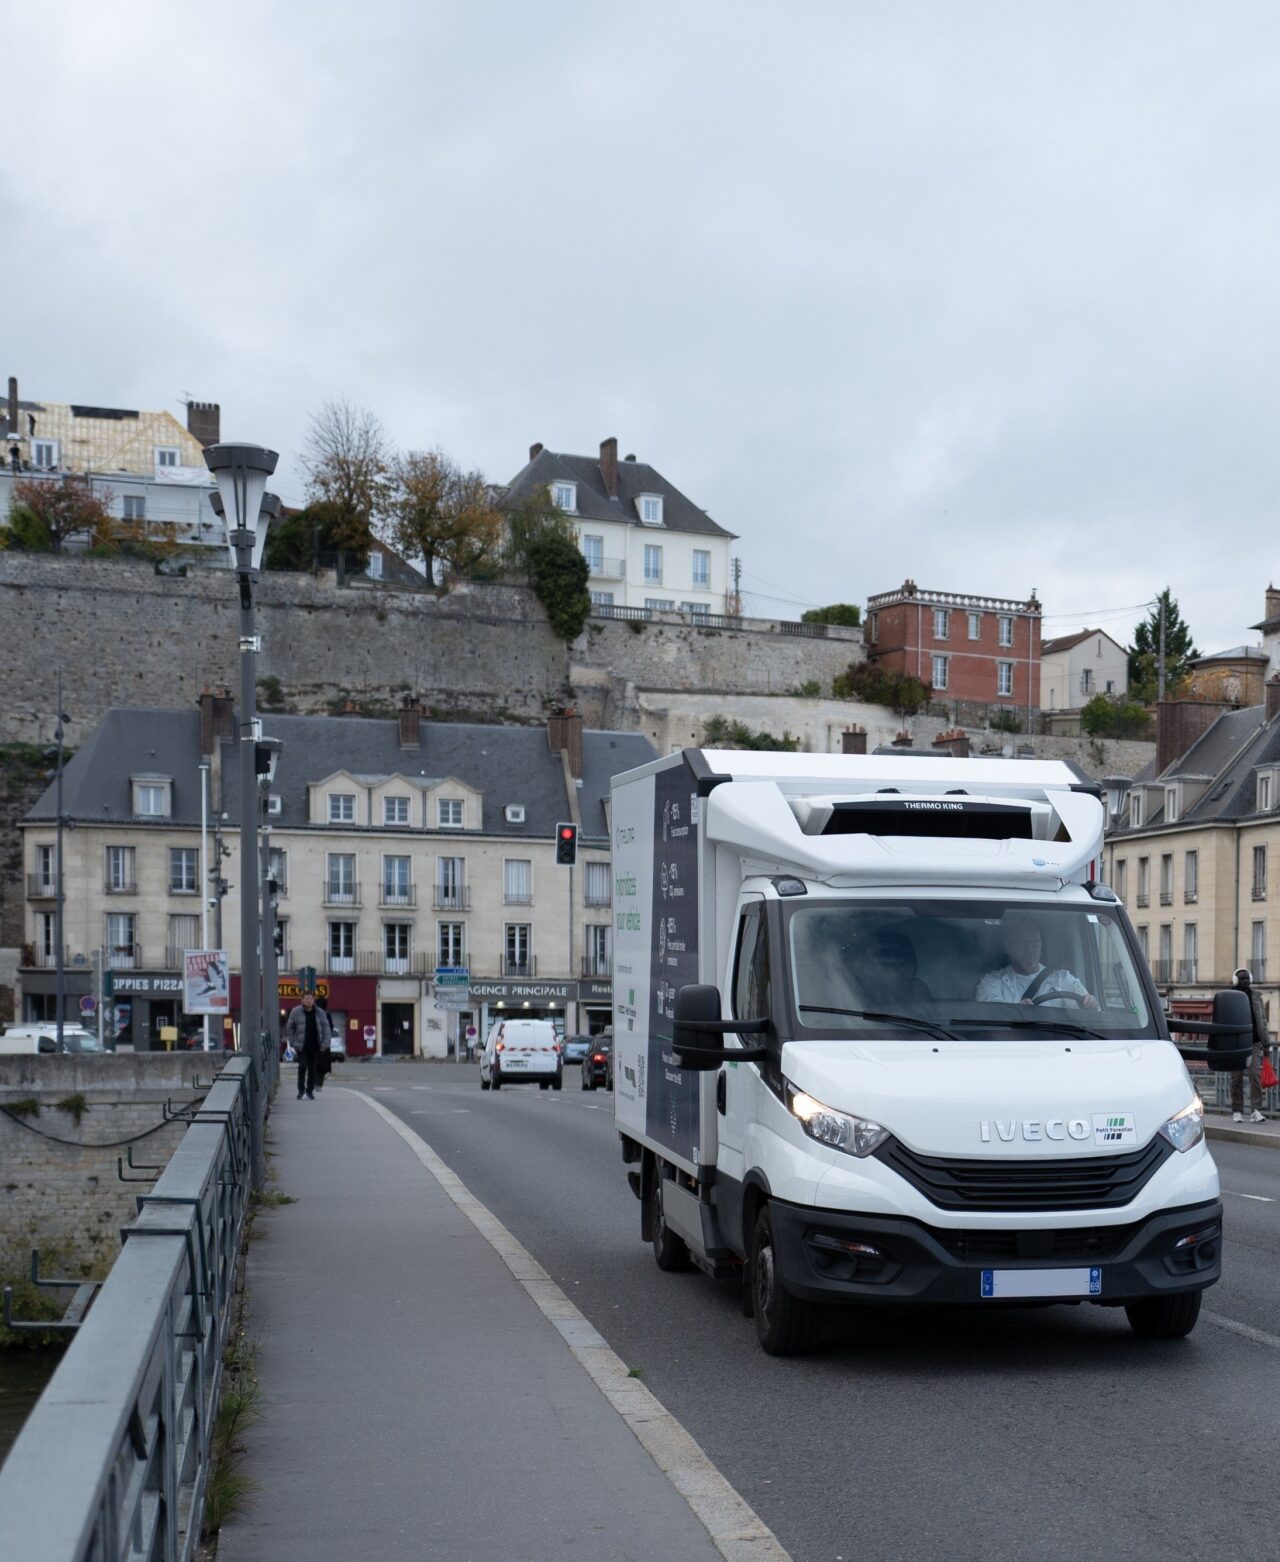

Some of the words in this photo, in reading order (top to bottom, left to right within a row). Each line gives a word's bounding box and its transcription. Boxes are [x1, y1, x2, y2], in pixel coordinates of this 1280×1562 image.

[113, 979, 149, 990] OPPIES
[153, 979, 185, 991] PIZZA
[278, 984, 326, 995] NICOAS
[592, 984, 612, 993] Rest
[468, 986, 507, 995] AGENCE
[511, 986, 567, 997] PRINCIPALE
[979, 1119, 1091, 1142] IVECO
[1090, 1282, 1100, 1291] 69
